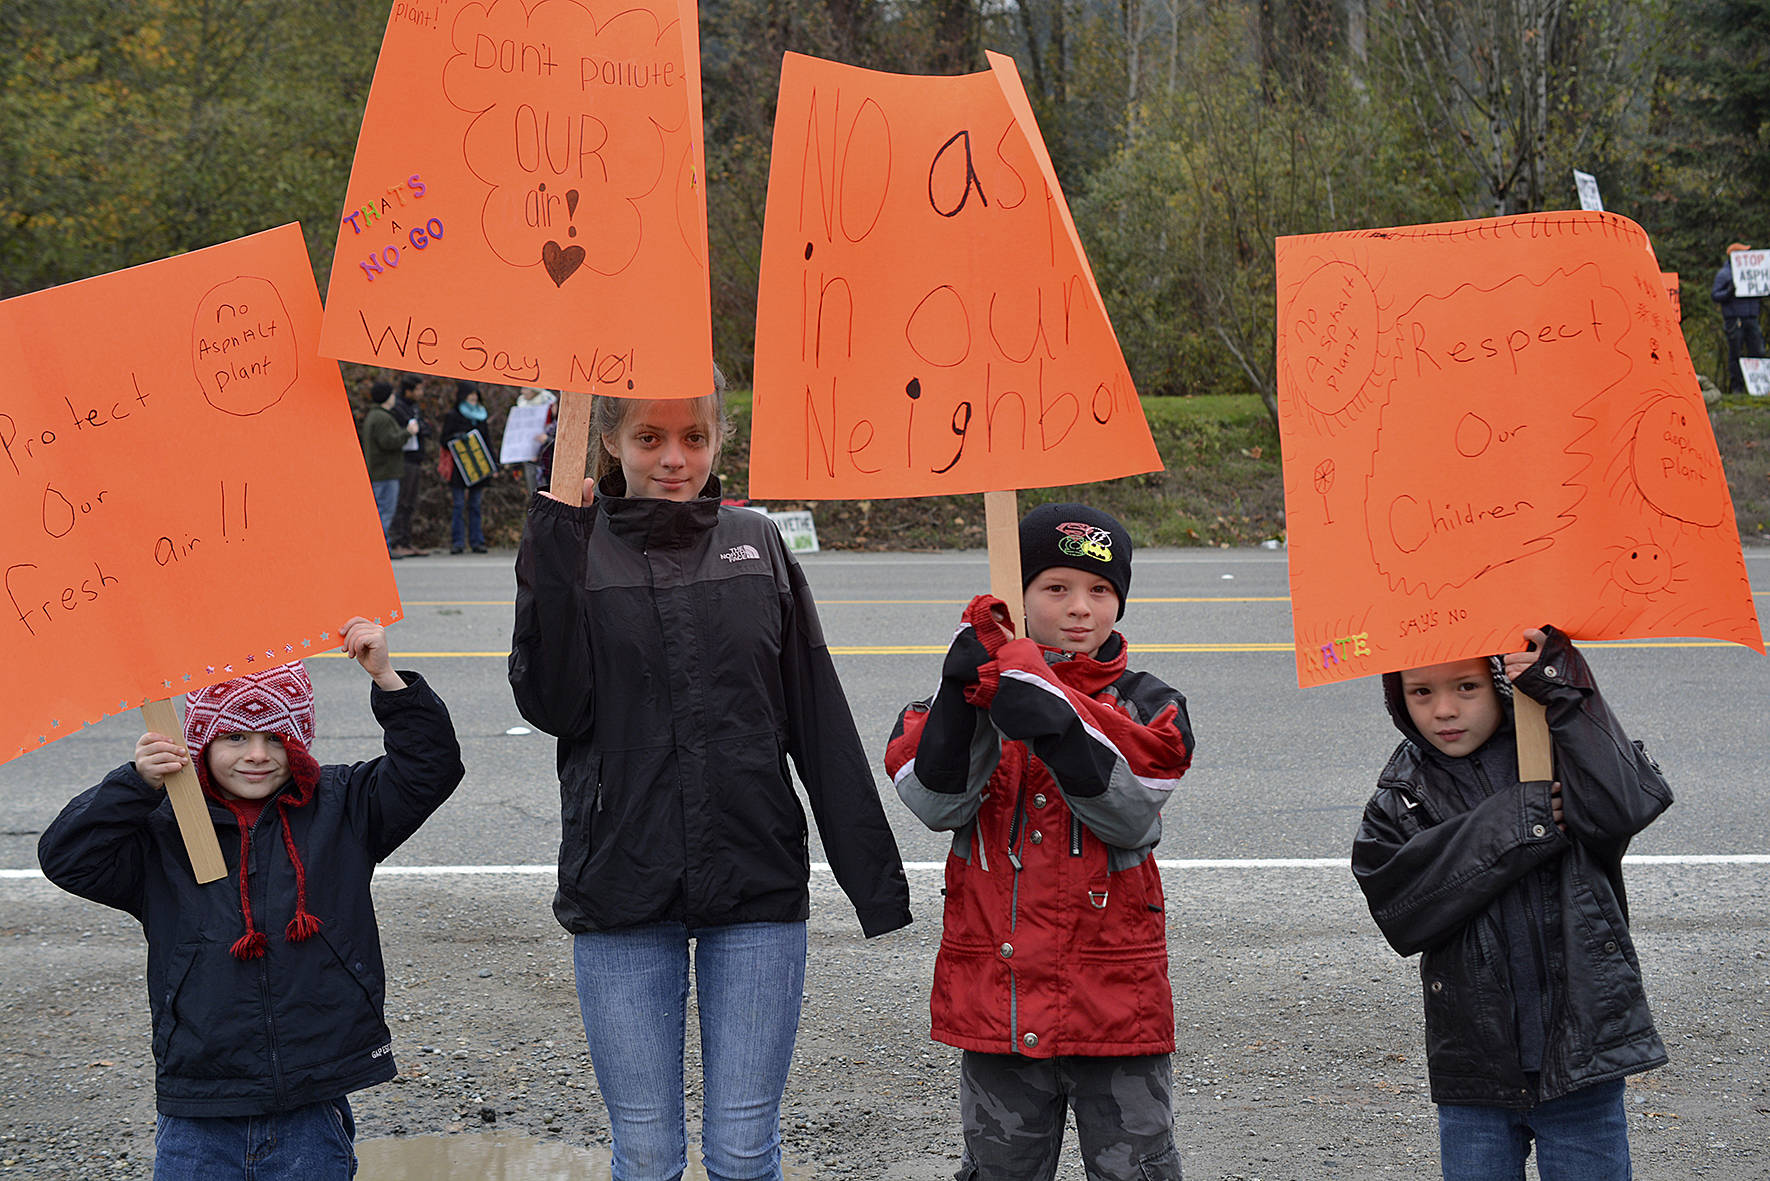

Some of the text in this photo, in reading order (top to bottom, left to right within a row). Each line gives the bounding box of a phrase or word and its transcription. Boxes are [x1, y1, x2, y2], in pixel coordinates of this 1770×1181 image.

[473, 33, 559, 77] Don't
[514, 103, 608, 183] OUR
[799, 86, 892, 243] NO
[390, 219, 402, 235] A
[1735, 254, 1765, 267] STOP
[802, 240, 853, 369] in
[358, 309, 439, 367] We
[1410, 299, 1604, 377] Respect
[0, 372, 151, 476] Protect
[1454, 411, 1527, 458] Our
[42, 481, 108, 539] Our
[1388, 493, 1535, 554] Children
